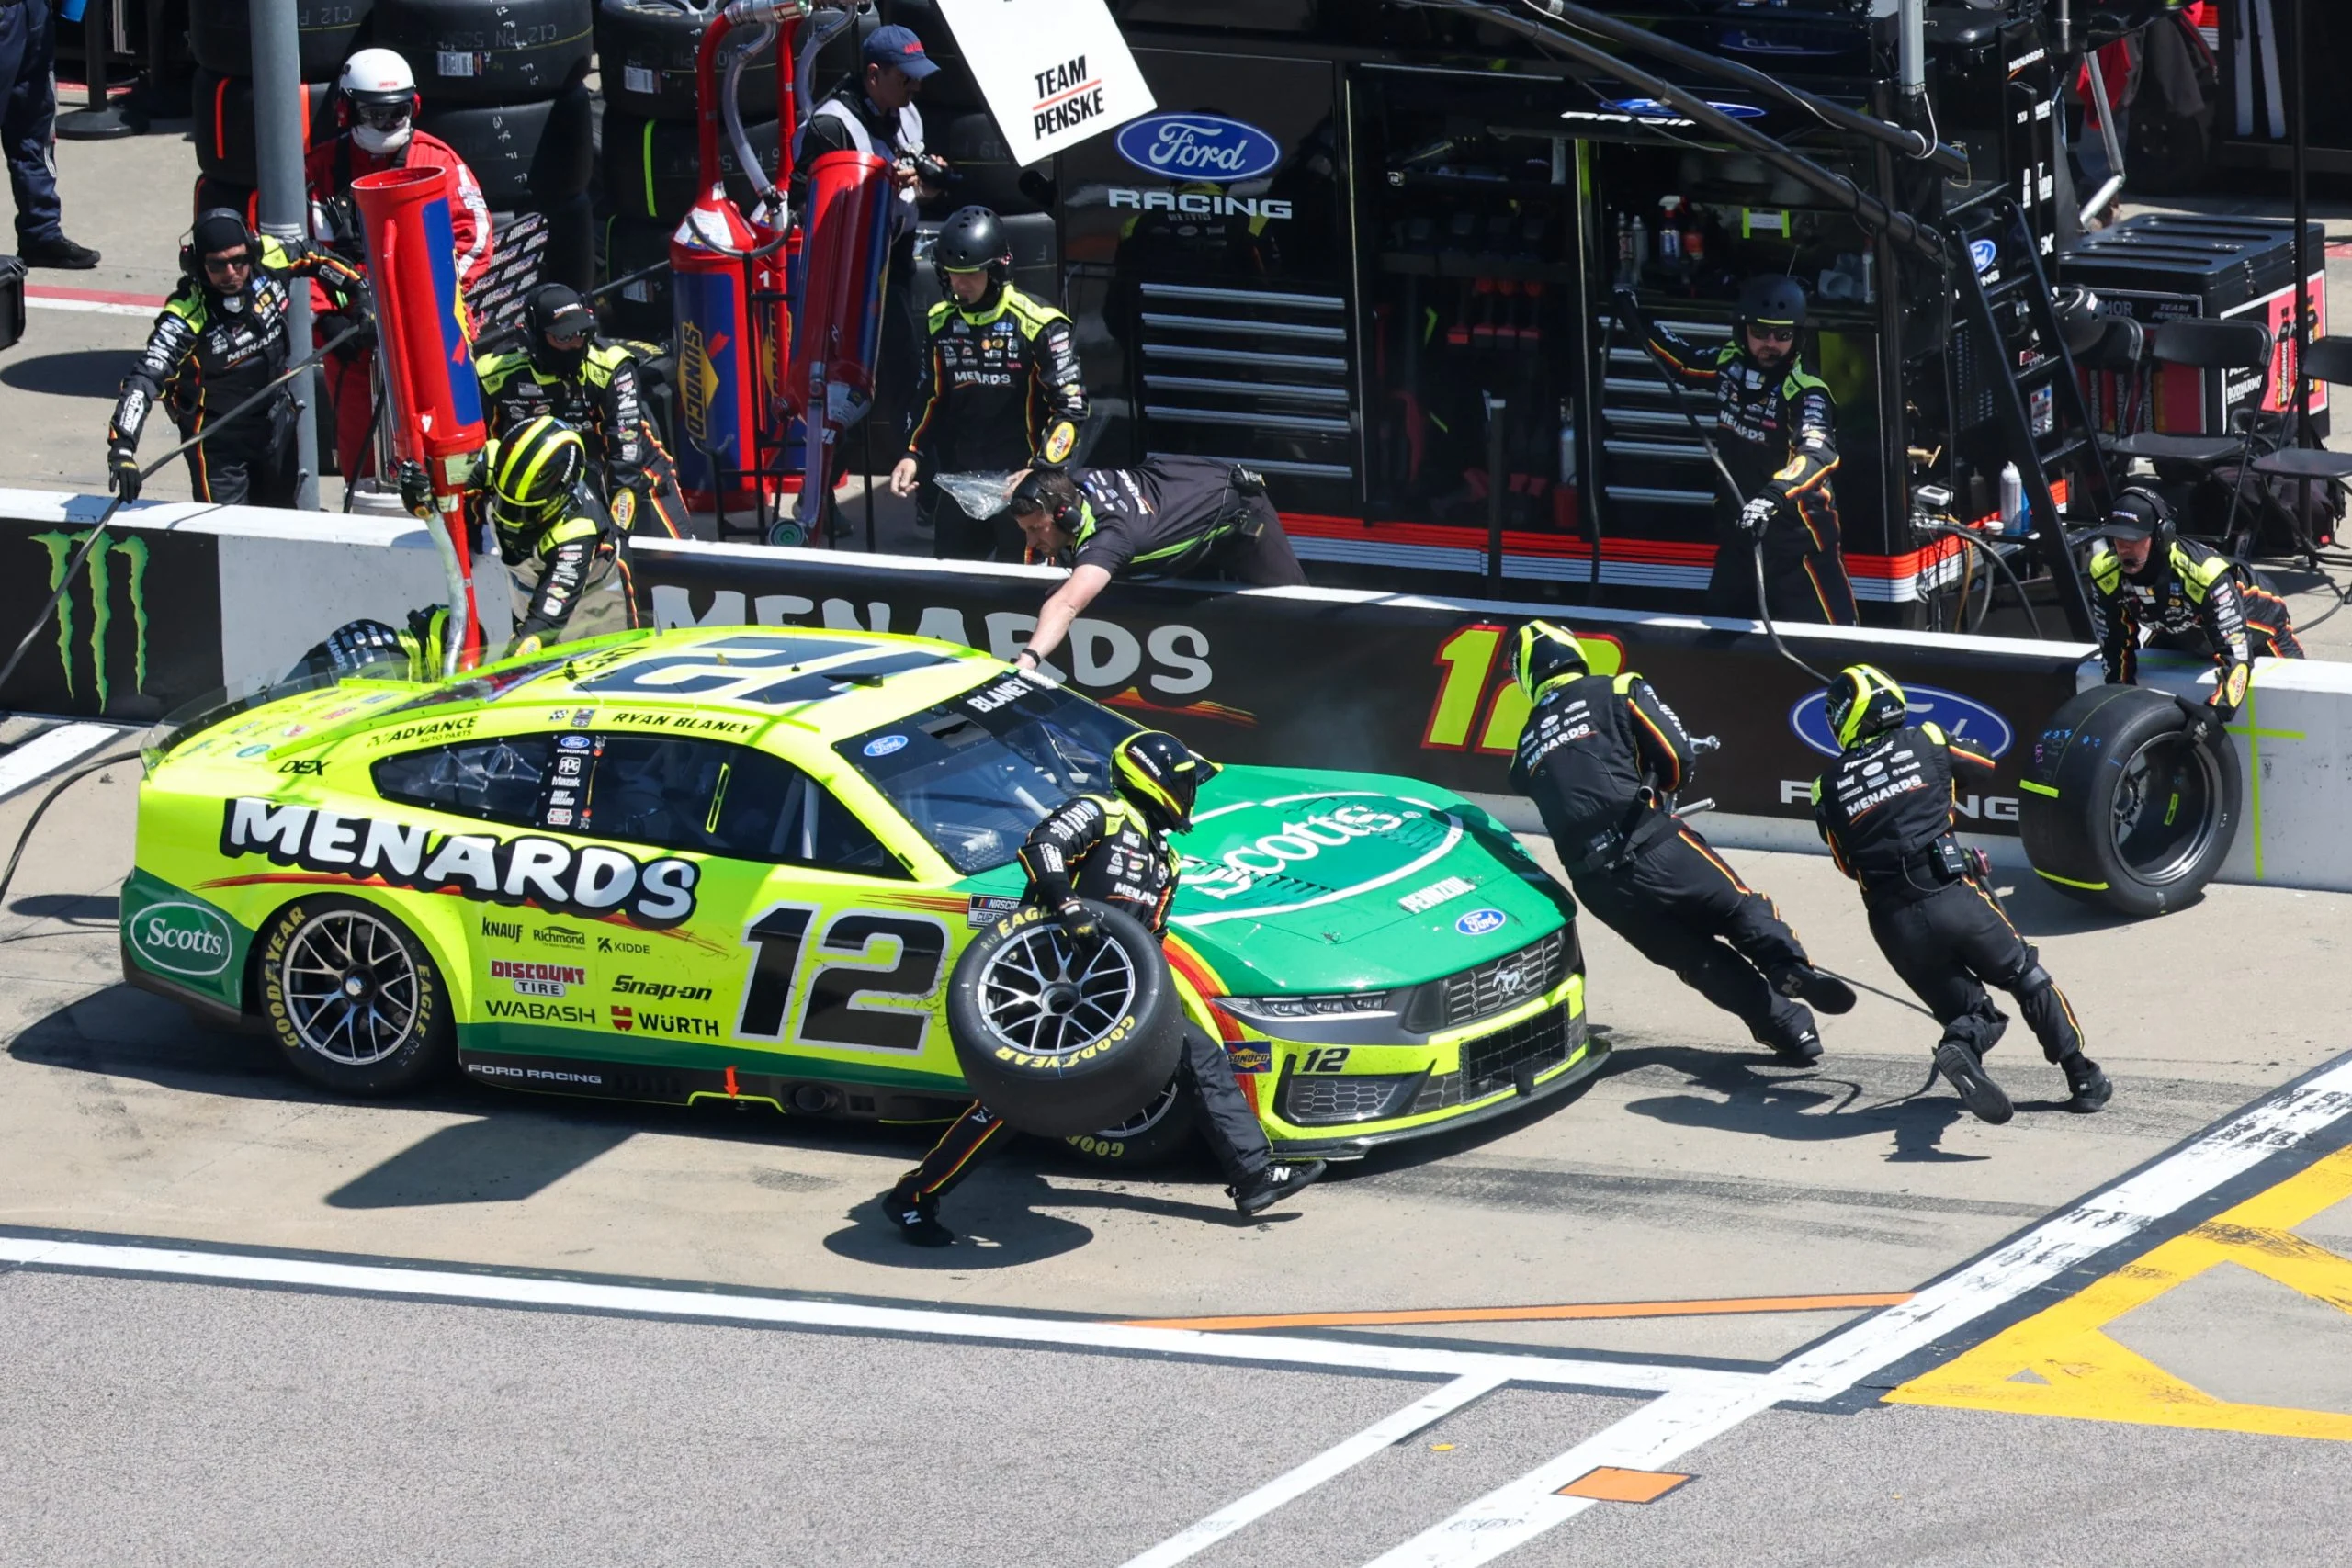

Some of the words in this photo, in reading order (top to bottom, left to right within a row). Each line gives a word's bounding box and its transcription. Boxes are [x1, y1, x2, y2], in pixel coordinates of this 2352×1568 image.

[1035, 54, 1087, 99] TEAM
[1033, 87, 1104, 140] PENSKE
[1148, 121, 1250, 172] Ford
[1108, 188, 1293, 220] RACING
[759, 270, 771, 288] 1
[683, 321, 707, 440] SUNOCO
[955, 371, 1011, 386] MERDS
[967, 678, 1034, 715] BLANEY
[1420, 623, 1627, 757] 12
[388, 716, 479, 743] ADVANCE
[612, 712, 665, 726] RYAN
[673, 716, 756, 734] BLANEY
[1527, 723, 1590, 769] MENARDS
[277, 760, 332, 776] DEX
[551, 776, 581, 787] Mazak
[1781, 779, 2019, 822] RNG
[1846, 774, 1922, 817] MENARDS
[226, 798, 695, 924] MENARDS
[145, 918, 223, 956] Scotts
[533, 928, 586, 946] Richmond
[997, 905, 1054, 940] EAGL
[1466, 912, 1503, 933] Ford
[614, 942, 650, 954] KIDDE
[264, 905, 306, 1048] GOODYEAR
[491, 960, 586, 986] DISCOUNT
[518, 981, 561, 996] TIRE
[611, 974, 713, 1002] Snap-on
[733, 900, 952, 1057] 12
[415, 964, 433, 1038] EAGLE
[485, 999, 596, 1024] WABASH
[994, 1014, 1136, 1069] GOODYEAR
[468, 1064, 524, 1077] FORD
[527, 1069, 602, 1085] RACING
[1227, 1053, 1270, 1067] SUNOCO
[1301, 1047, 1351, 1073] 12
